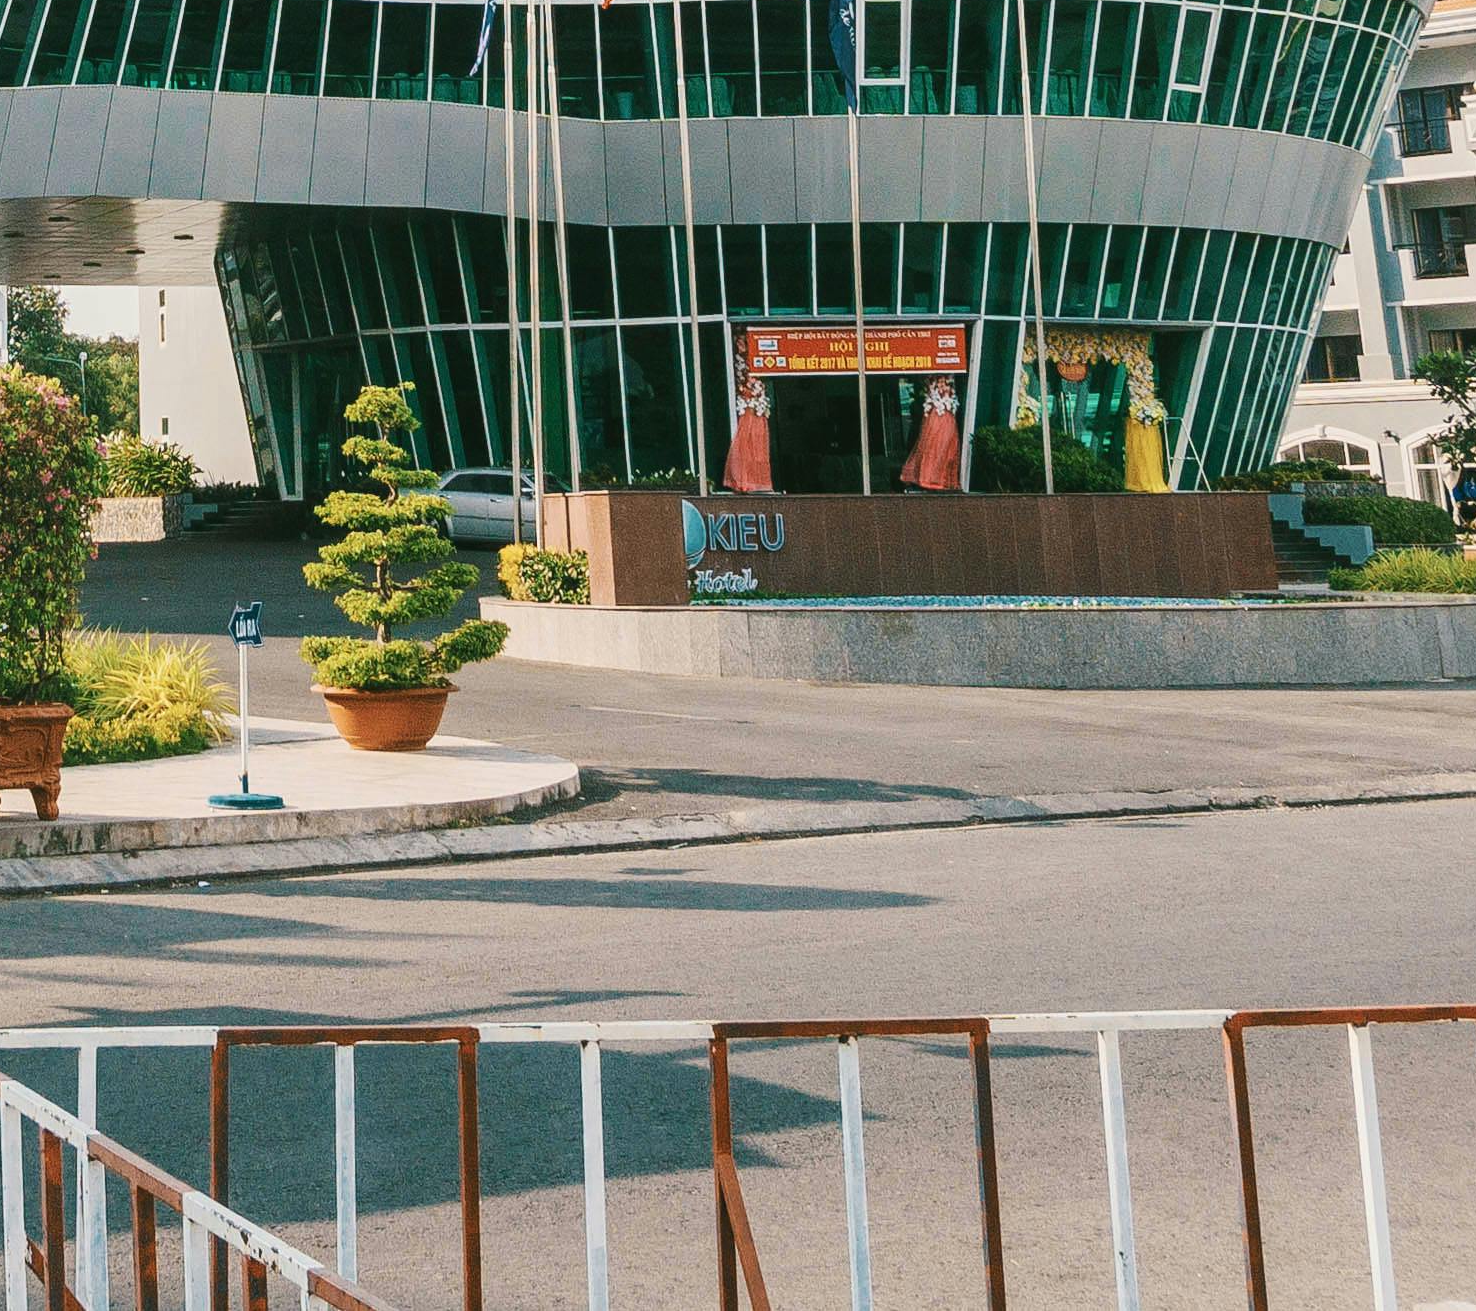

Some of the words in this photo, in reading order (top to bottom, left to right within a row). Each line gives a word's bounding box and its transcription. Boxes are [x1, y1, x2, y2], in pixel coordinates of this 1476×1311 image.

[830, 340, 853, 353] HỘI
[865, 342, 889, 353] GHỊ
[708, 512, 786, 552] KIEU
[695, 567, 759, 594] Hotel
